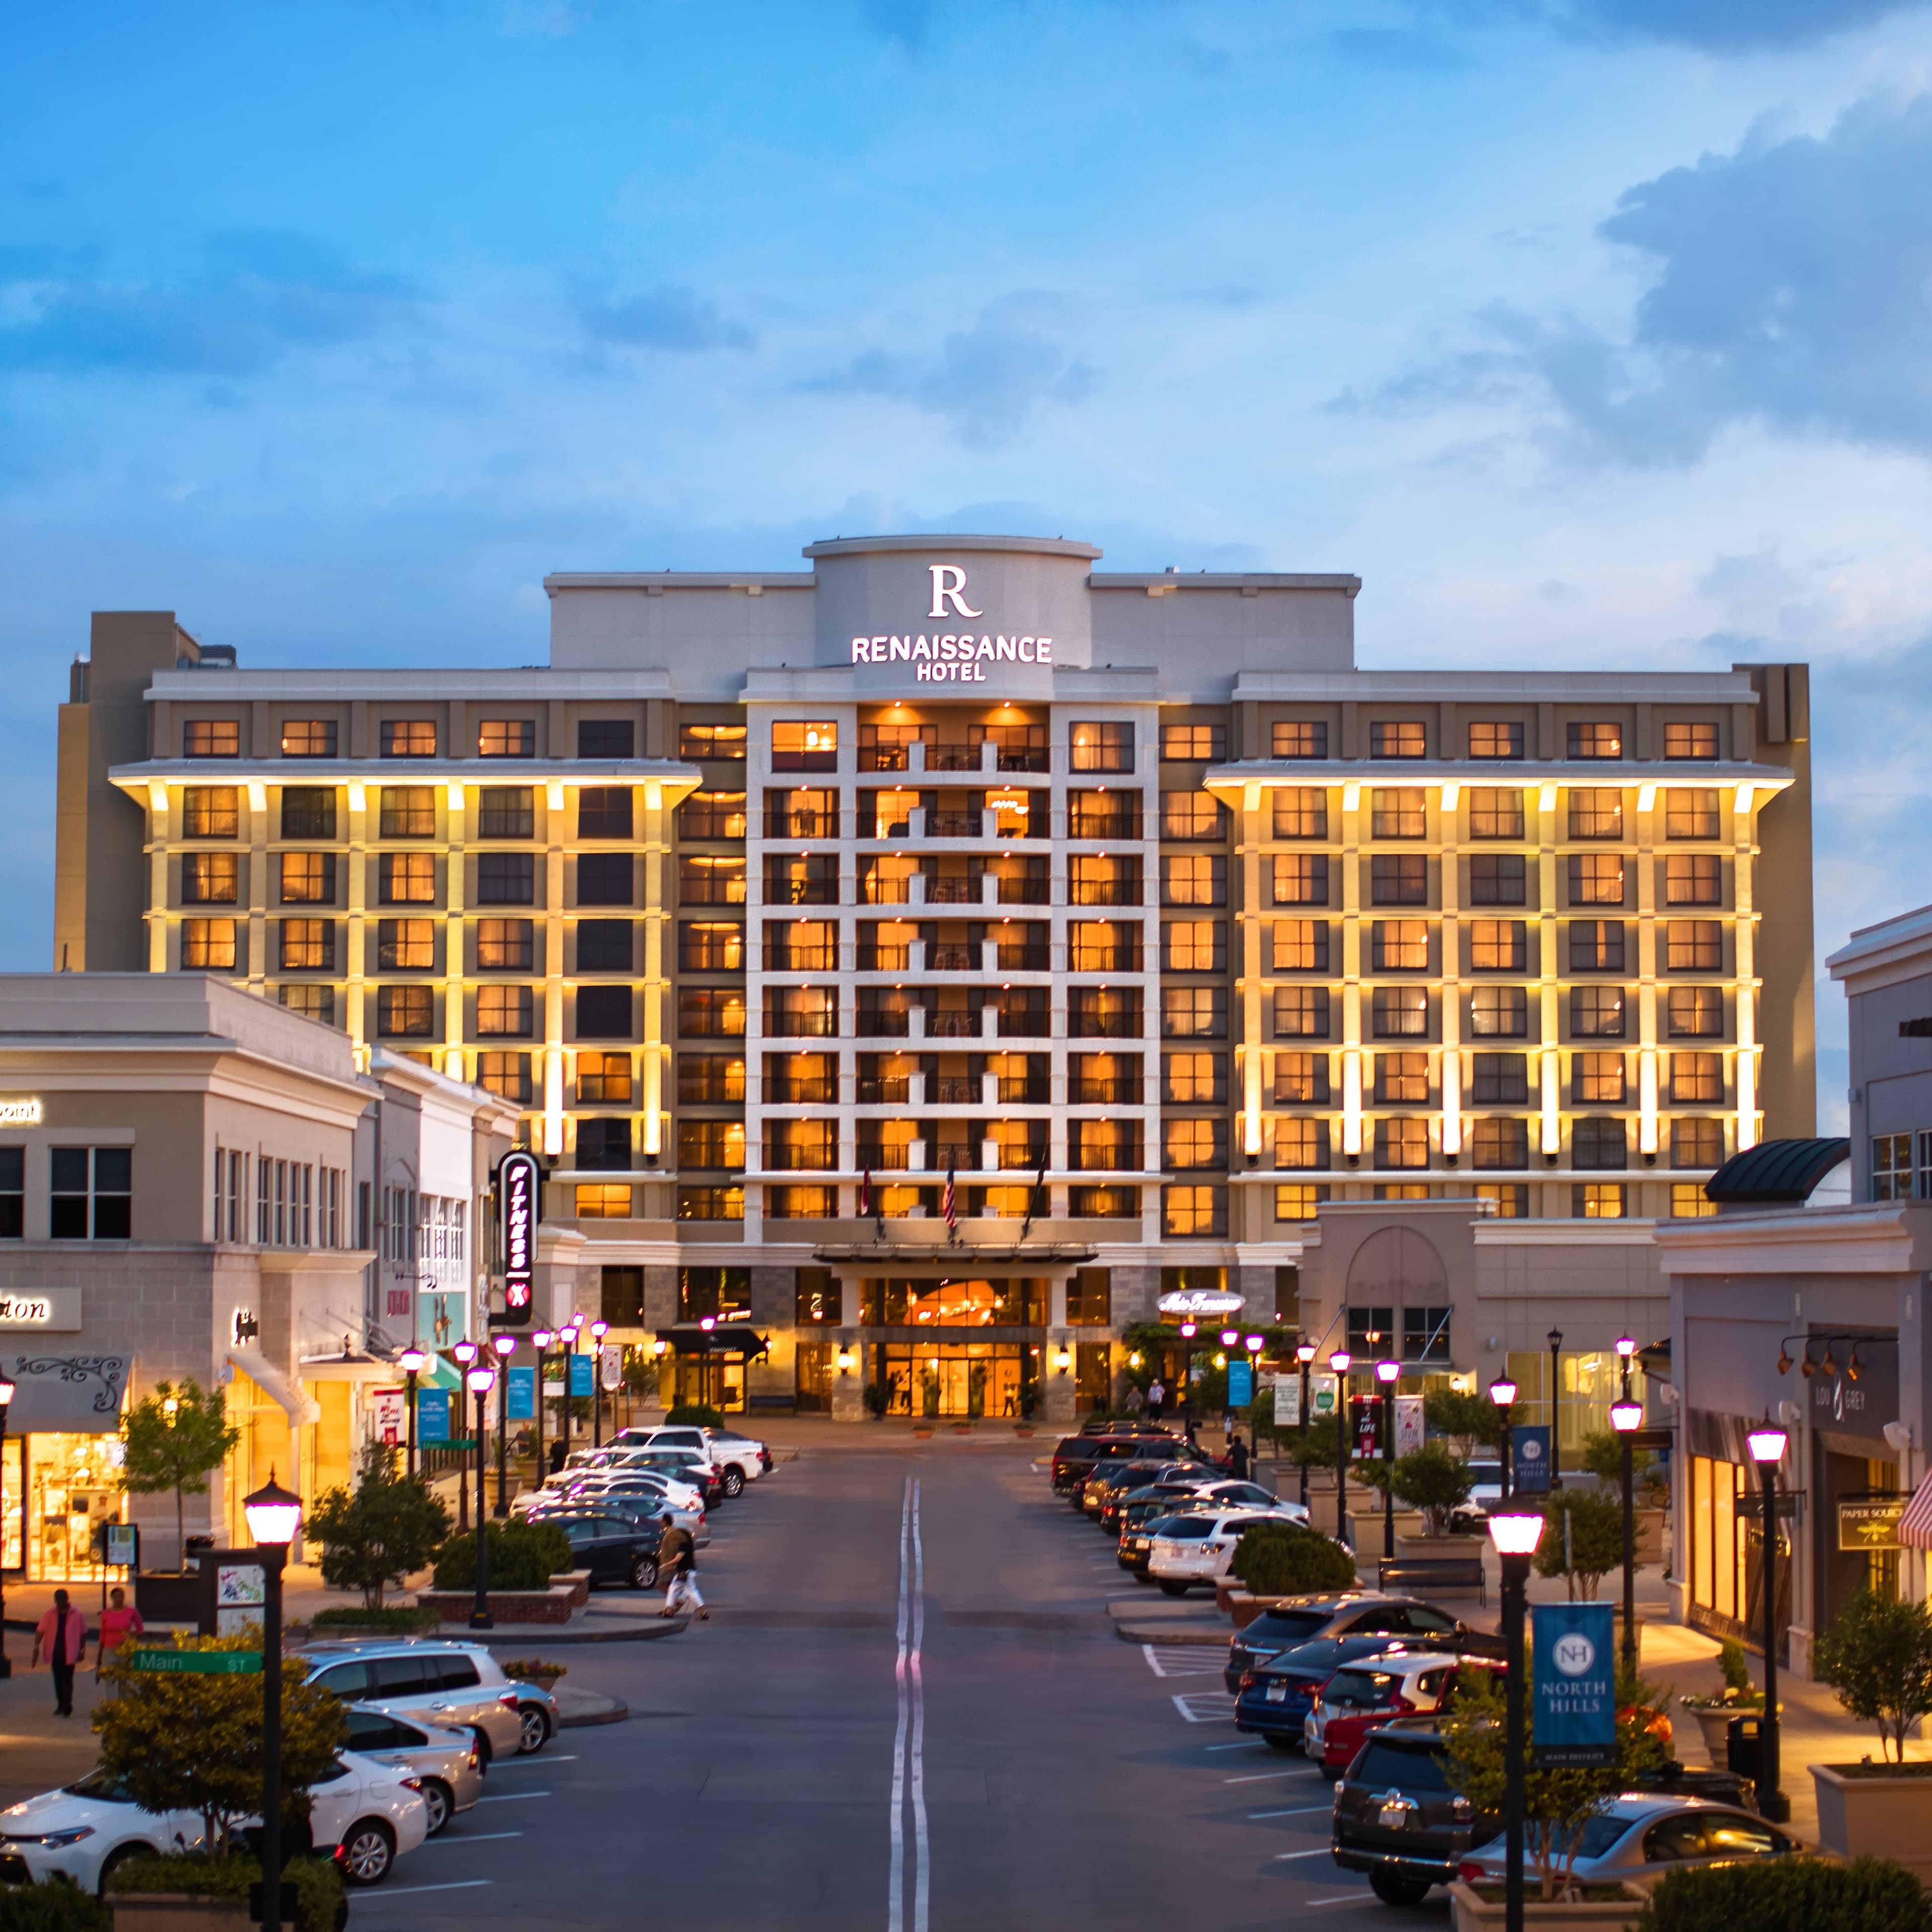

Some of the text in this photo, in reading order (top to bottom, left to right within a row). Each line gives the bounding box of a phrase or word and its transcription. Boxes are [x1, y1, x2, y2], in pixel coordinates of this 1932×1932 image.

[928, 565, 983, 618] R
[852, 635, 1053, 664] RENAISSANCE
[917, 663, 986, 681] HOTEL
[510, 1166, 528, 1268] FITNESS
[1816, 1387, 1865, 1411] LOU GREY
[1359, 1423, 1376, 1433] LIFE
[1842, 1509, 1869, 1518] PAPER
[140, 1653, 246, 1672] Main ST
[1561, 1646, 1587, 1663] NH
[1542, 1681, 1606, 1696] NORTH
[1551, 1698, 1600, 1713] HILLS
